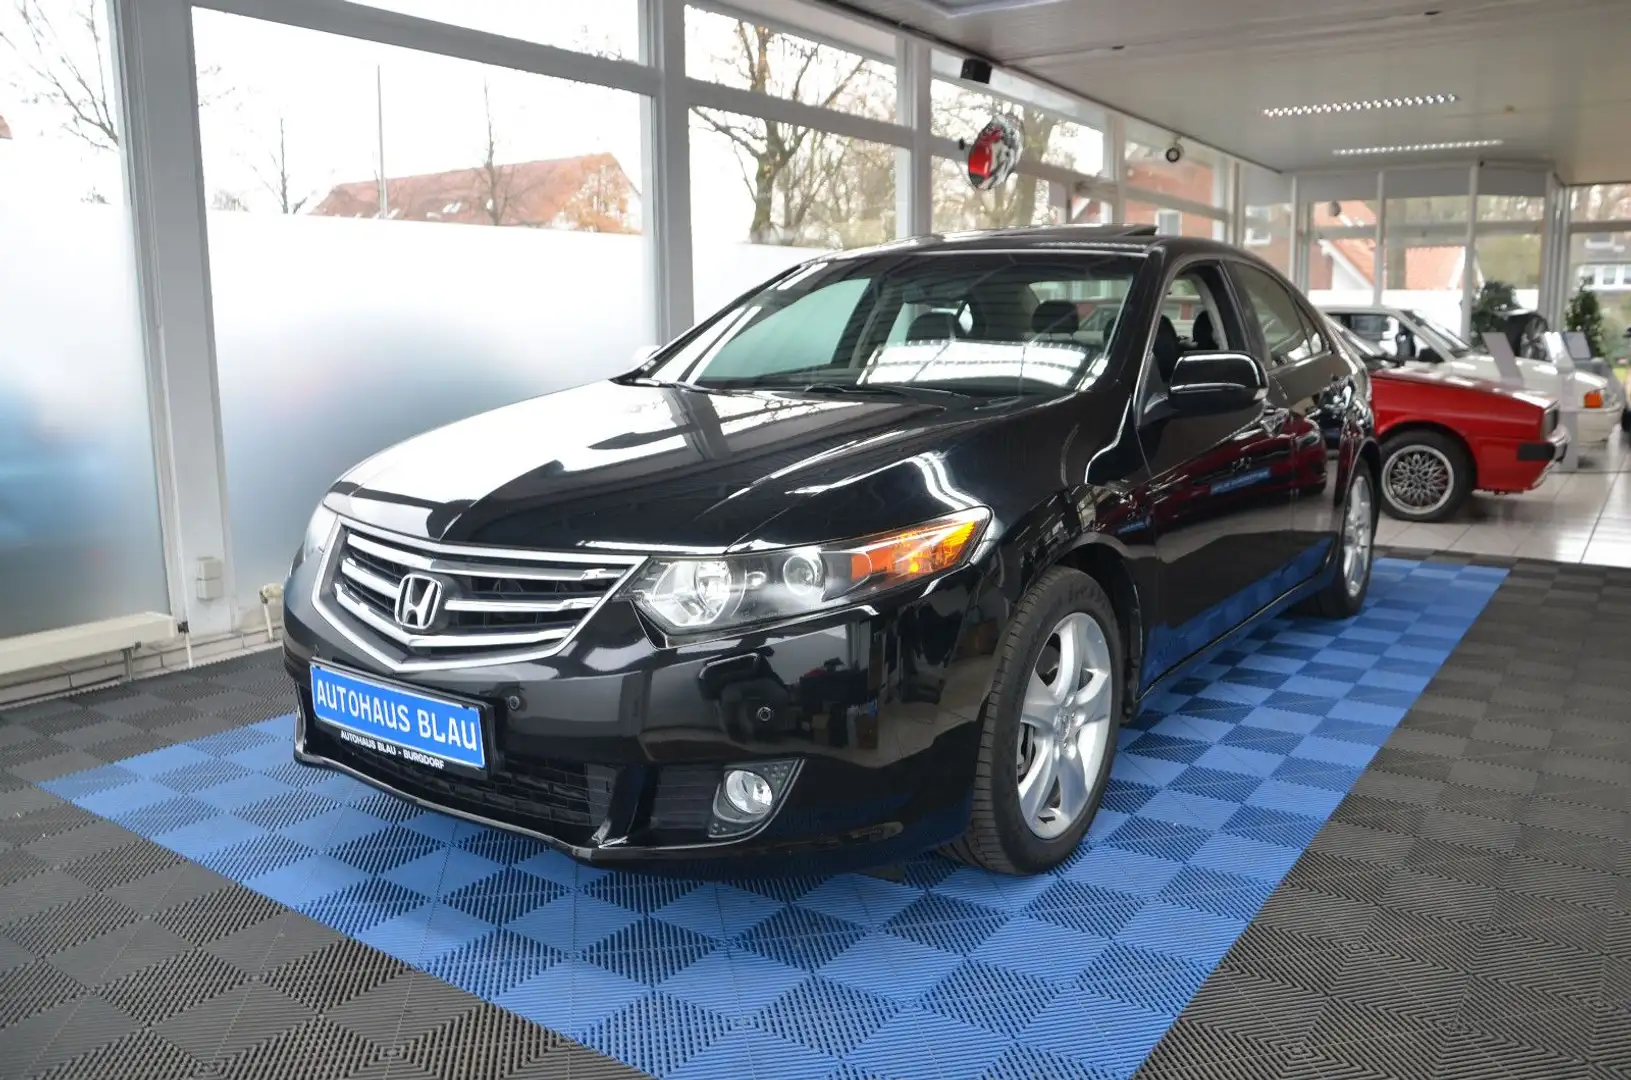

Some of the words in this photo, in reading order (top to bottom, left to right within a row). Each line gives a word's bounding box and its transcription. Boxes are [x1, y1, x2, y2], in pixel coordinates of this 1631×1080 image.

[317, 679, 411, 732] AUTOHAUS
[417, 709, 477, 750] BLAU
[341, 730, 376, 750] AUTOHAUS
[377, 741, 397, 756] BLAU
[403, 748, 445, 770] BURGDORF
